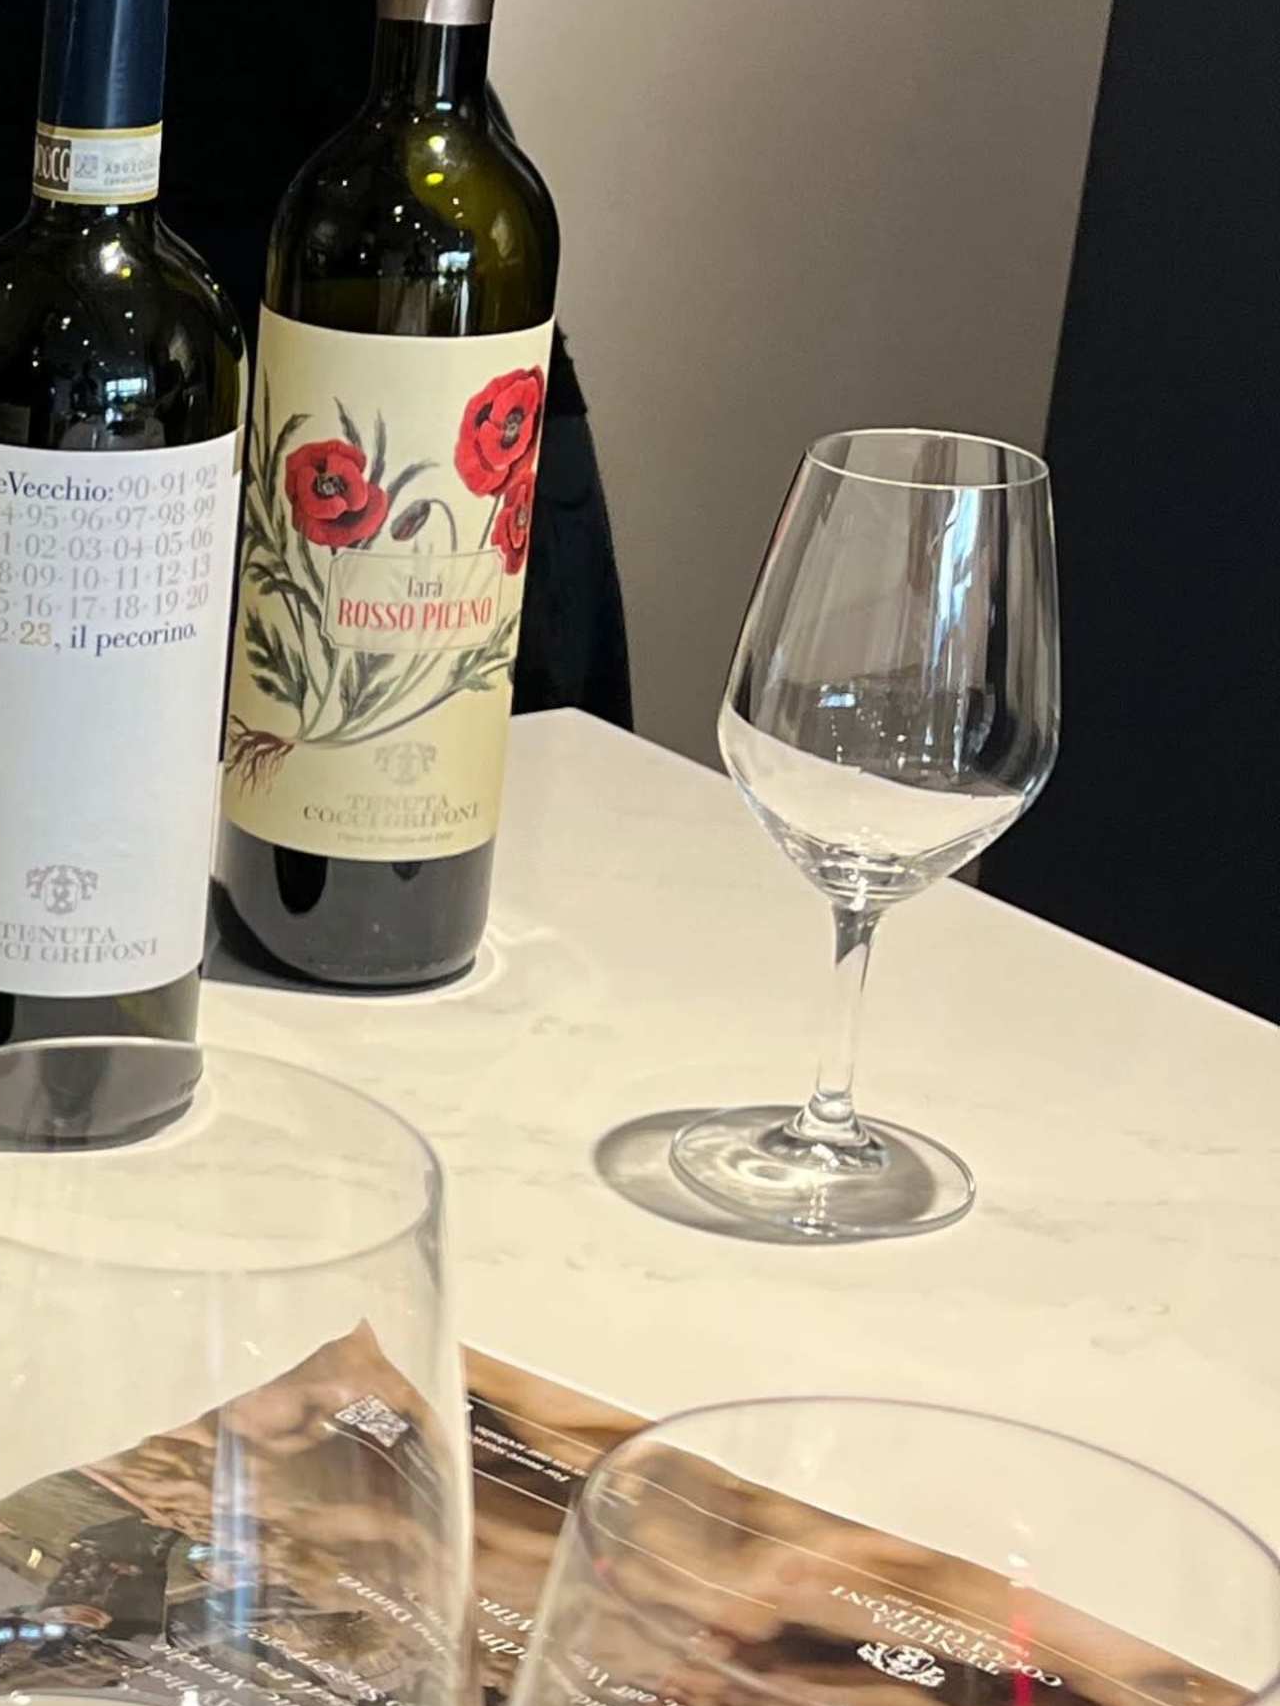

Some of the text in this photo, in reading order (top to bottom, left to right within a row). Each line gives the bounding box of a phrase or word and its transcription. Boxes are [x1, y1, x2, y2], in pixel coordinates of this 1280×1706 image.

[338, 596, 493, 632] ROSSO PICENO
[70, 625, 87, 649] il
[39, 937, 159, 964] GRIFONI
[869, 1610, 1003, 1675] TENUTA
[969, 1640, 1063, 1687] COCCI
